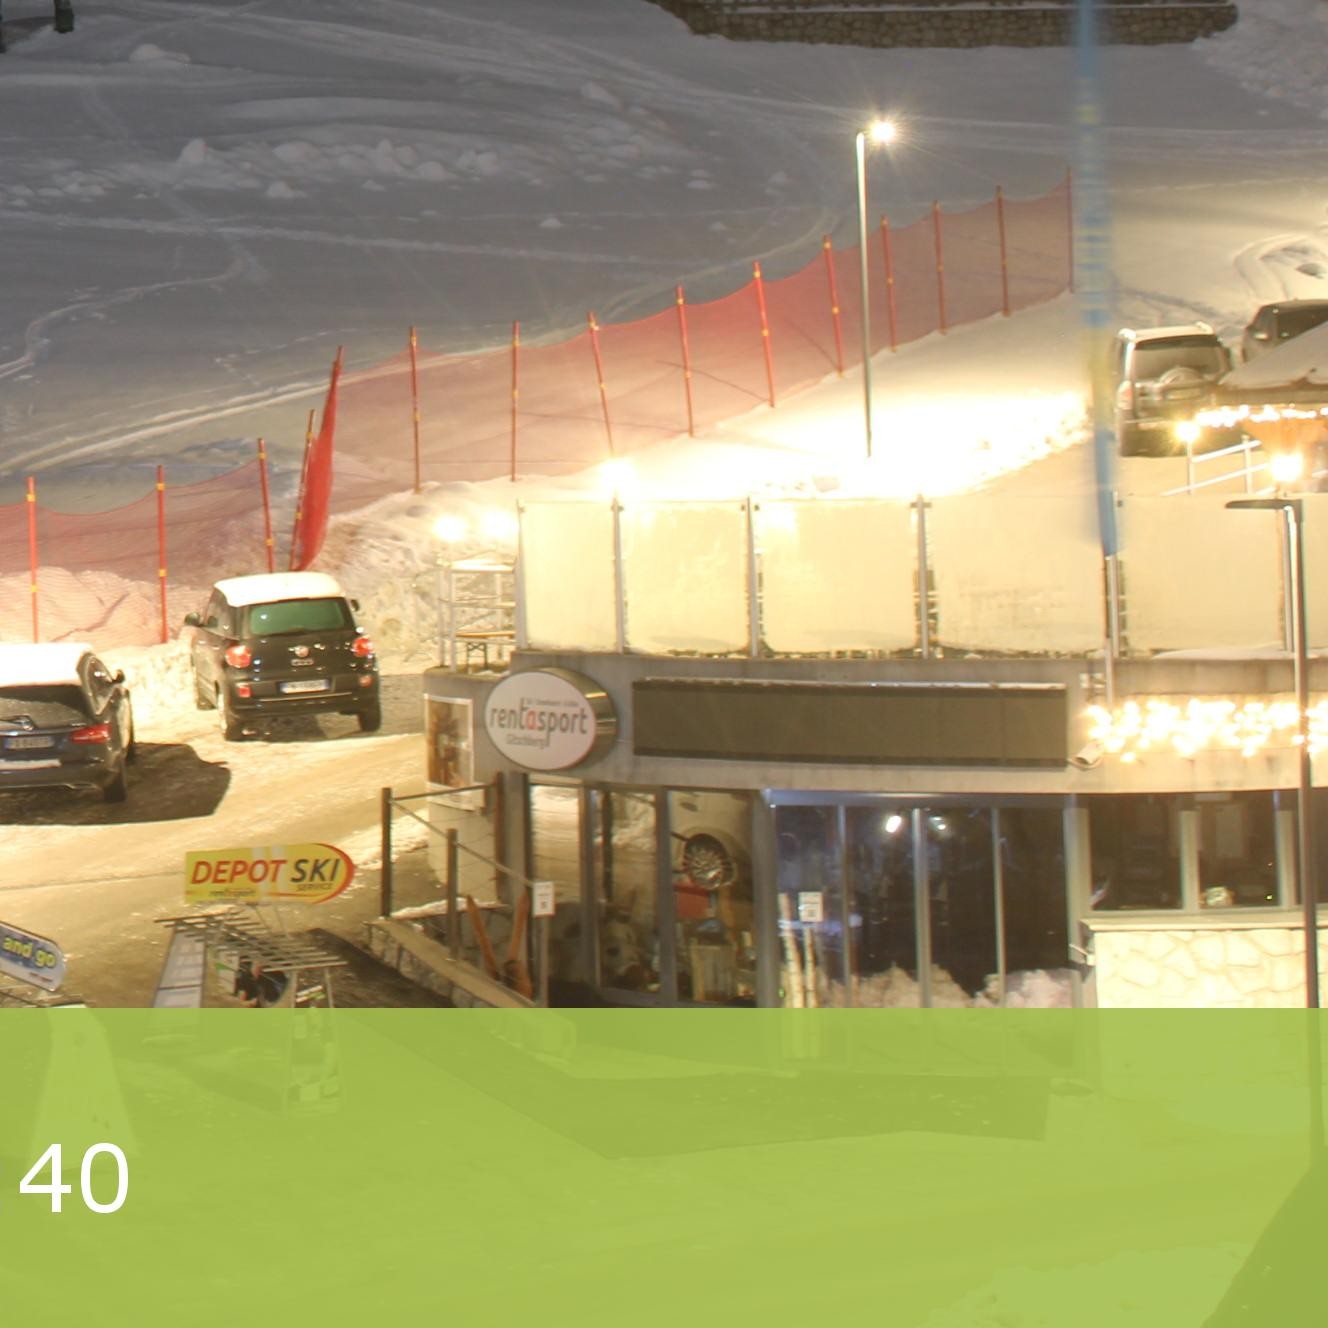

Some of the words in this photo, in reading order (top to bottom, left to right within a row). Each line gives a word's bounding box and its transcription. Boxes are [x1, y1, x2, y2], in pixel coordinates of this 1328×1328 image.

[490, 697, 588, 747] rentasport
[191, 859, 288, 885] DEPOT
[290, 858, 342, 883] SKI
[2, 936, 34, 959] and
[34, 947, 57, 969] go
